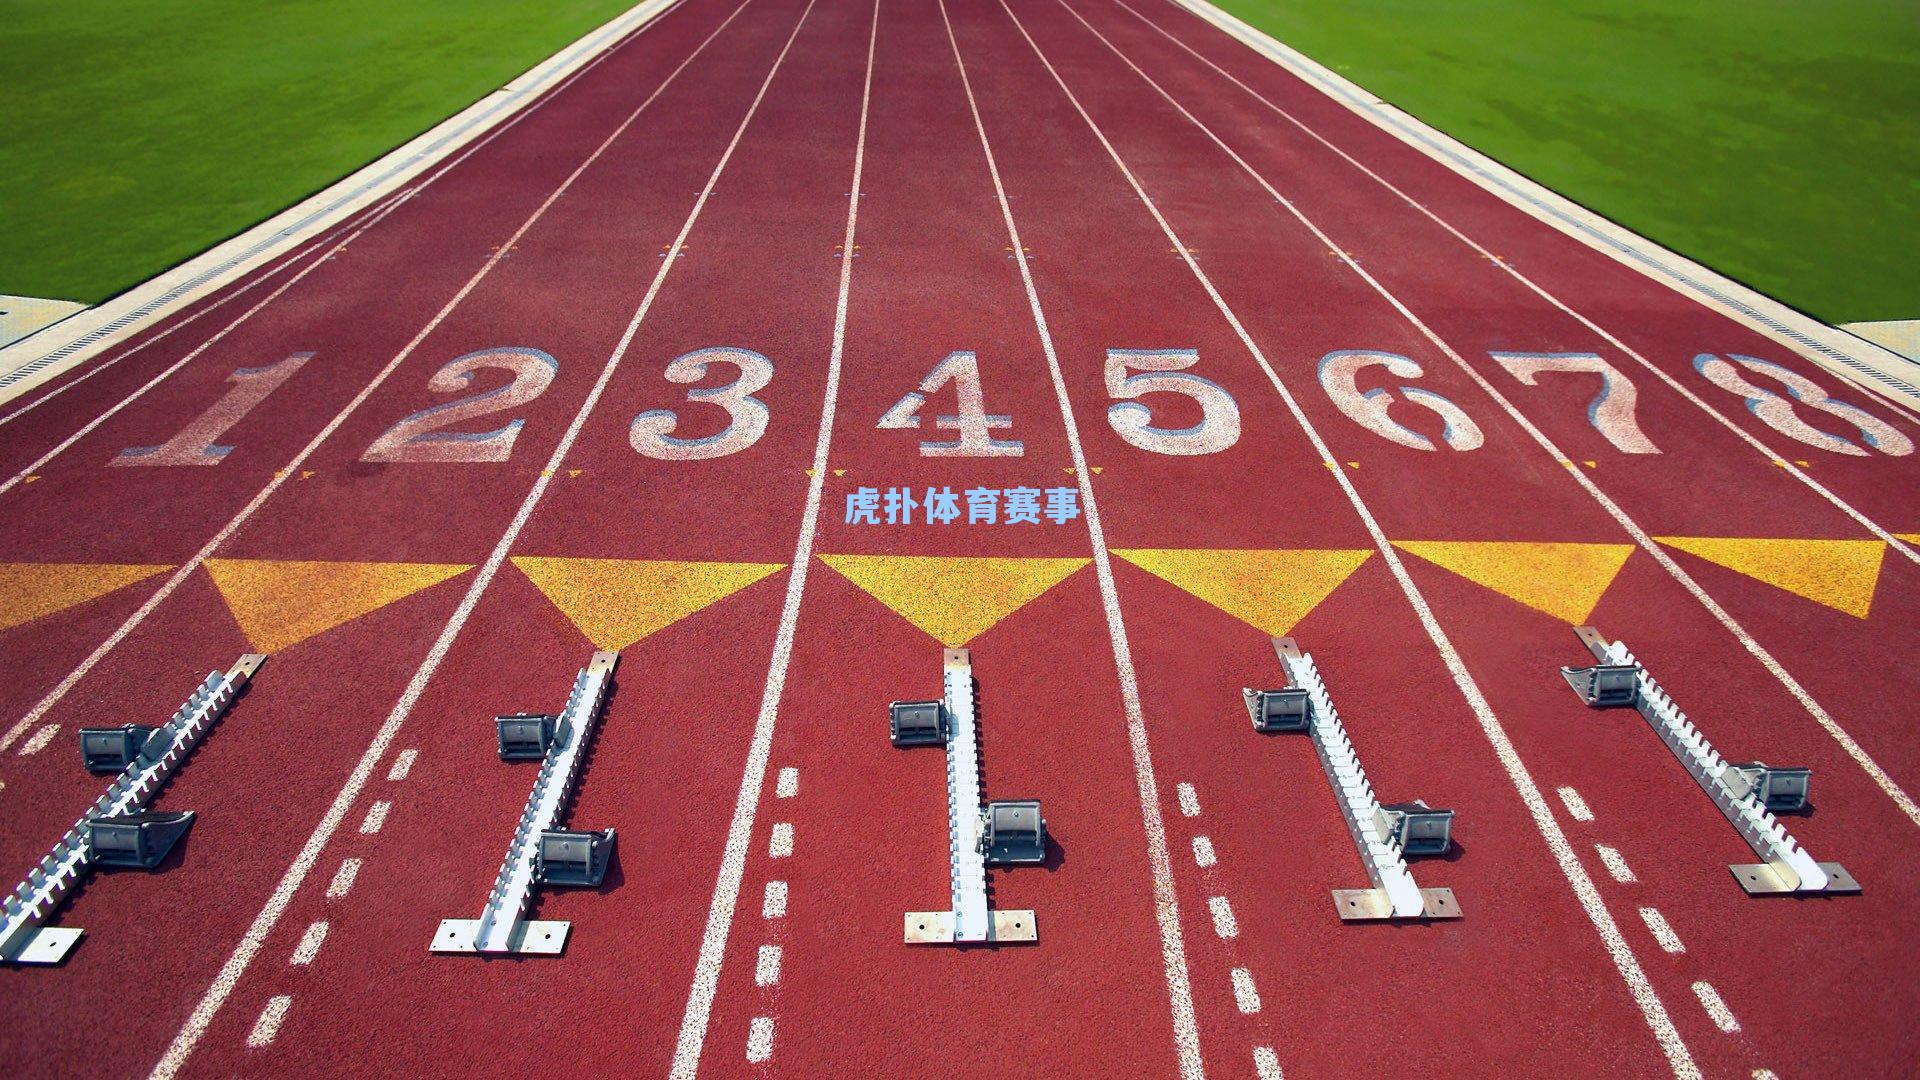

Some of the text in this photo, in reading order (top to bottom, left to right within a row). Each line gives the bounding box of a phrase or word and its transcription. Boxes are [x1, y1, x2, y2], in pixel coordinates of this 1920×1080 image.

[105, 351, 316, 466] 1
[359, 347, 559, 463] 2
[629, 347, 774, 461] 3
[876, 350, 1025, 457] 4
[1104, 348, 1241, 456] 5
[1317, 349, 1485, 452] 6
[1488, 351, 1663, 454] 7
[1692, 353, 1915, 457] 8
